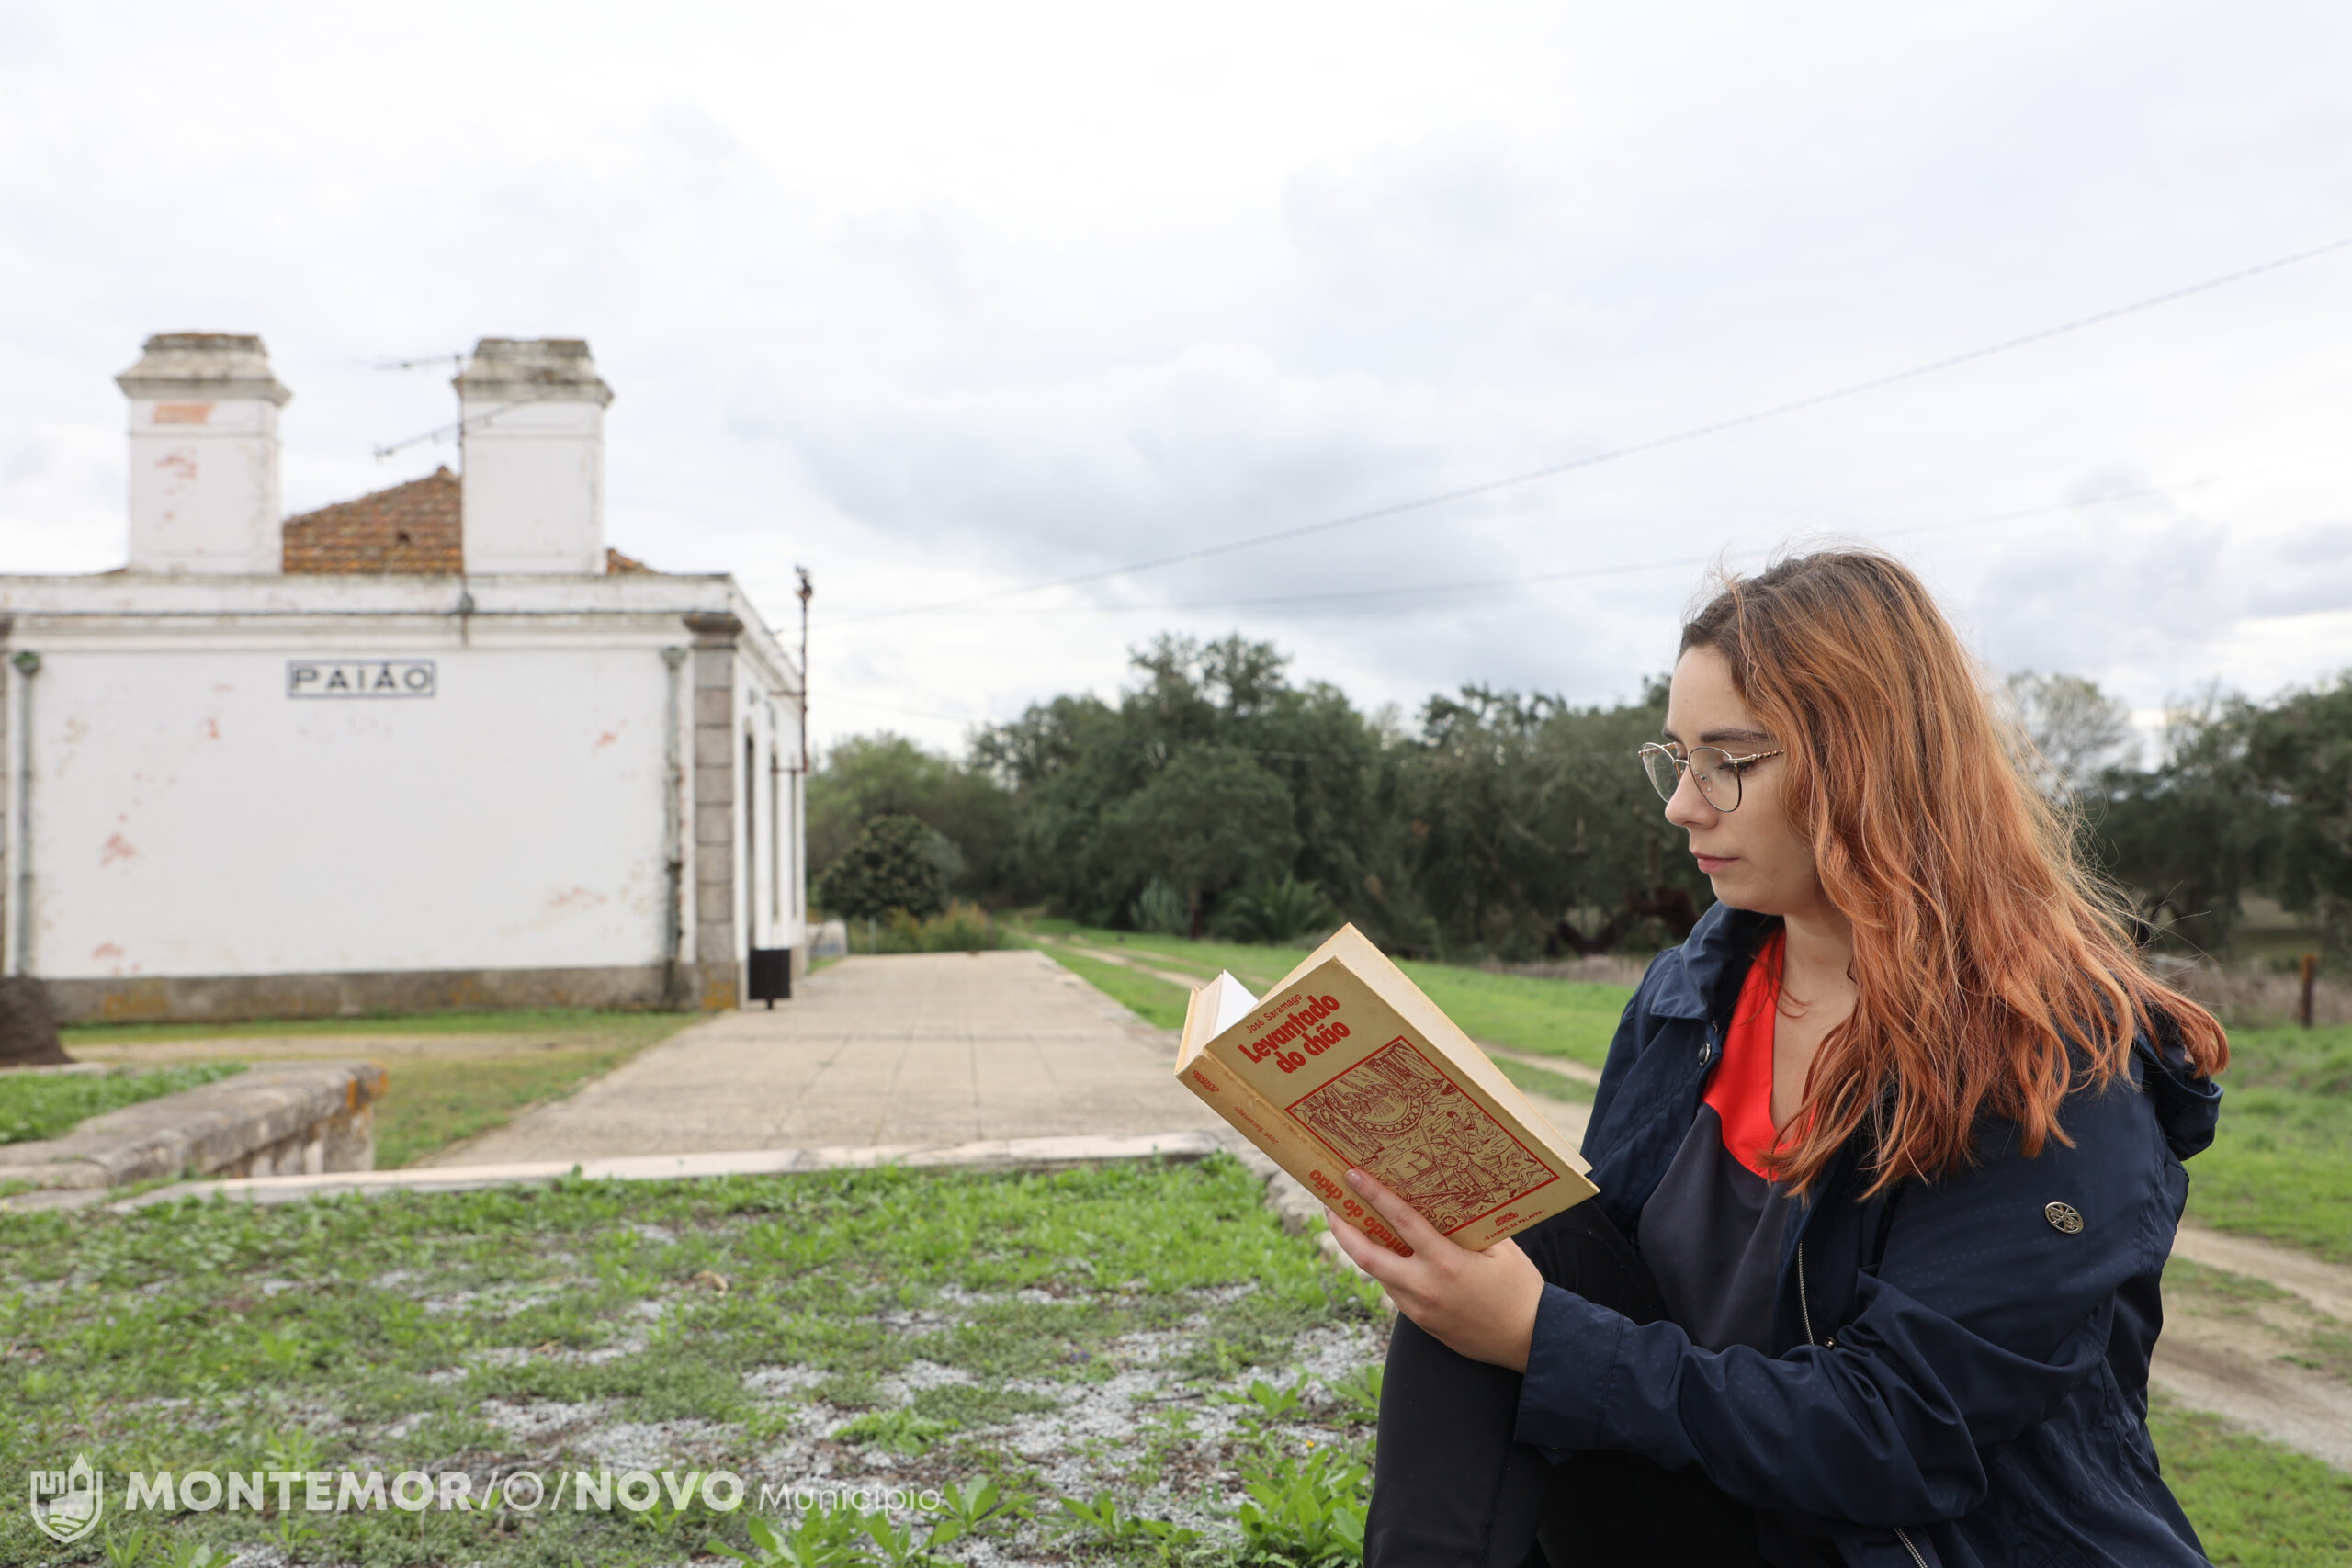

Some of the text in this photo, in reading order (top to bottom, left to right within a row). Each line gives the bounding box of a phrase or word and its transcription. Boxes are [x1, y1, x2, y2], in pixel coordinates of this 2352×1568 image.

[1237, 994, 1340, 1065] Levantado
[1246, 993, 1303, 1034] José Saramago
[1273, 1021, 1351, 1074] do chão
[1308, 1169, 1344, 1200] chão
[1342, 1198, 1365, 1218] do
